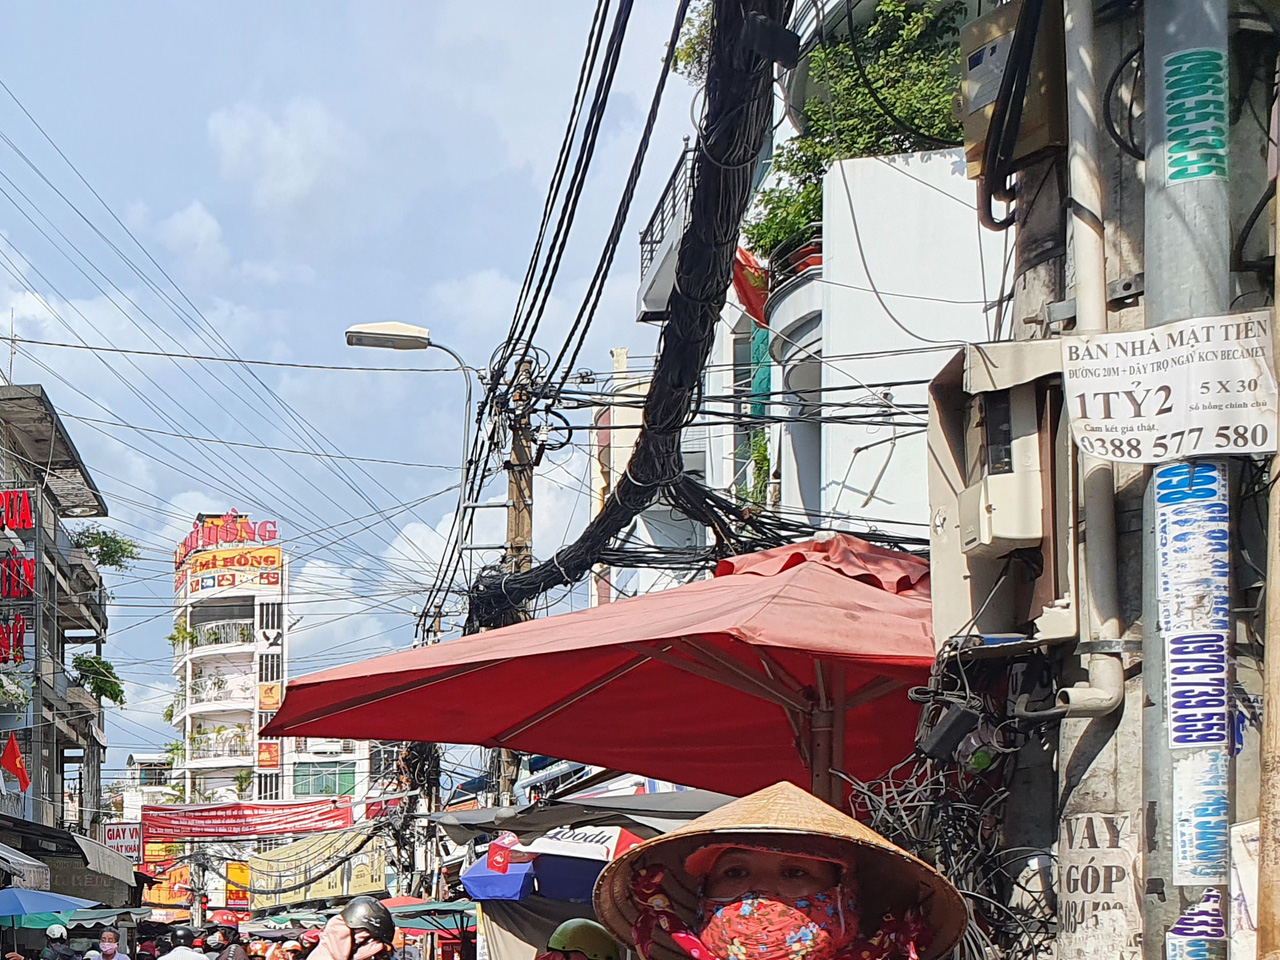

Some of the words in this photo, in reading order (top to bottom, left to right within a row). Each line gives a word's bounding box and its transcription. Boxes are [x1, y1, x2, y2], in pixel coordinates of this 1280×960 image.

[1068, 339, 1109, 362] BÁN
[1115, 333, 1160, 358] NHÀ
[1166, 324, 1215, 349] MẶT
[1219, 316, 1268, 341] TIỀN
[1068, 365, 1101, 379] ĐƯỜNG
[1102, 364, 1120, 377] 20M
[1150, 359, 1169, 374] TRỌ
[1198, 349, 1219, 362] KCN
[1220, 346, 1267, 361] BECAMEX
[1199, 381, 1211, 395] 5
[1216, 380, 1231, 394] X
[1236, 378, 1258, 393] 30
[1080, 436, 1142, 459] 0388
[1153, 427, 1204, 458] 577
[1214, 423, 1268, 449] 580
[1083, 423, 1103, 433] Cam
[1170, 634, 1226, 744] 0979.739.559
[1065, 815, 1129, 849] VAY
[1065, 856, 1127, 894] GÓP
